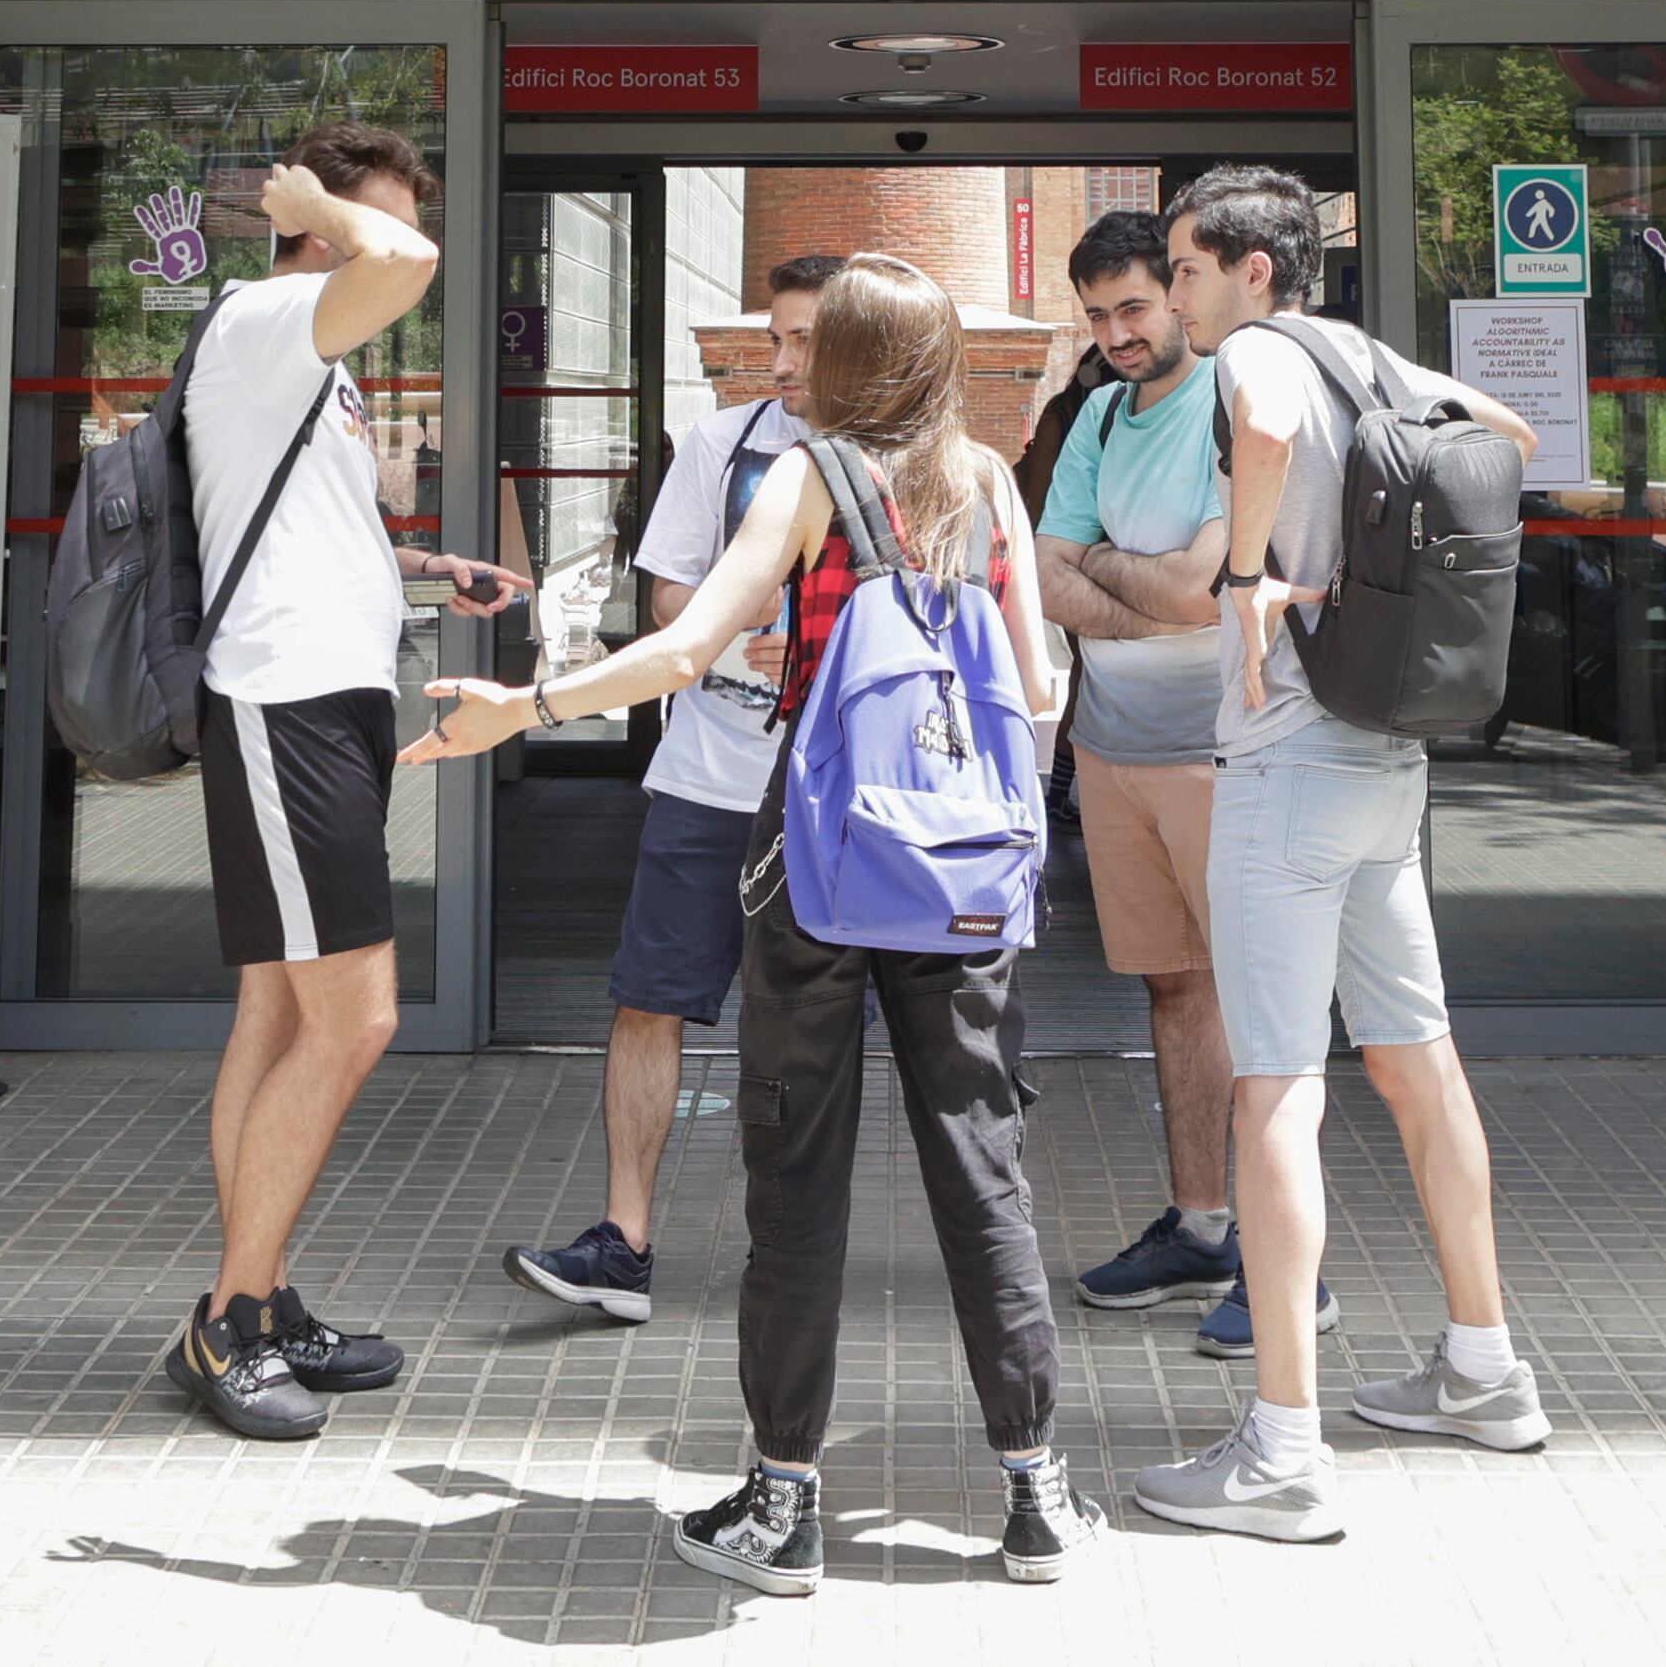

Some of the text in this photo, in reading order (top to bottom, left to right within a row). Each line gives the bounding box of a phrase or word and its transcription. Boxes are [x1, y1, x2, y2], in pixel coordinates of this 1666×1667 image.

[504, 67, 741, 87] Edifici Roc Boronat 53
[1094, 66, 1337, 87] Edifici Roc Boronat 52
[1016, 203, 1029, 213] 50
[1019, 252, 1029, 264] La
[1517, 262, 1569, 274] ENTRADA
[1019, 265, 1029, 294] Edifici
[1491, 317, 1543, 325] WORKSHOP
[1472, 338, 1565, 346] ACCOUNTABILITY AS
[1478, 349, 1557, 357] NORMATIVE IDEAL
[1497, 358, 1533, 367] CÀRREC
[1480, 370, 1558, 378] FRANK PASQUALE
[958, 922, 998, 931] EASTPAK
